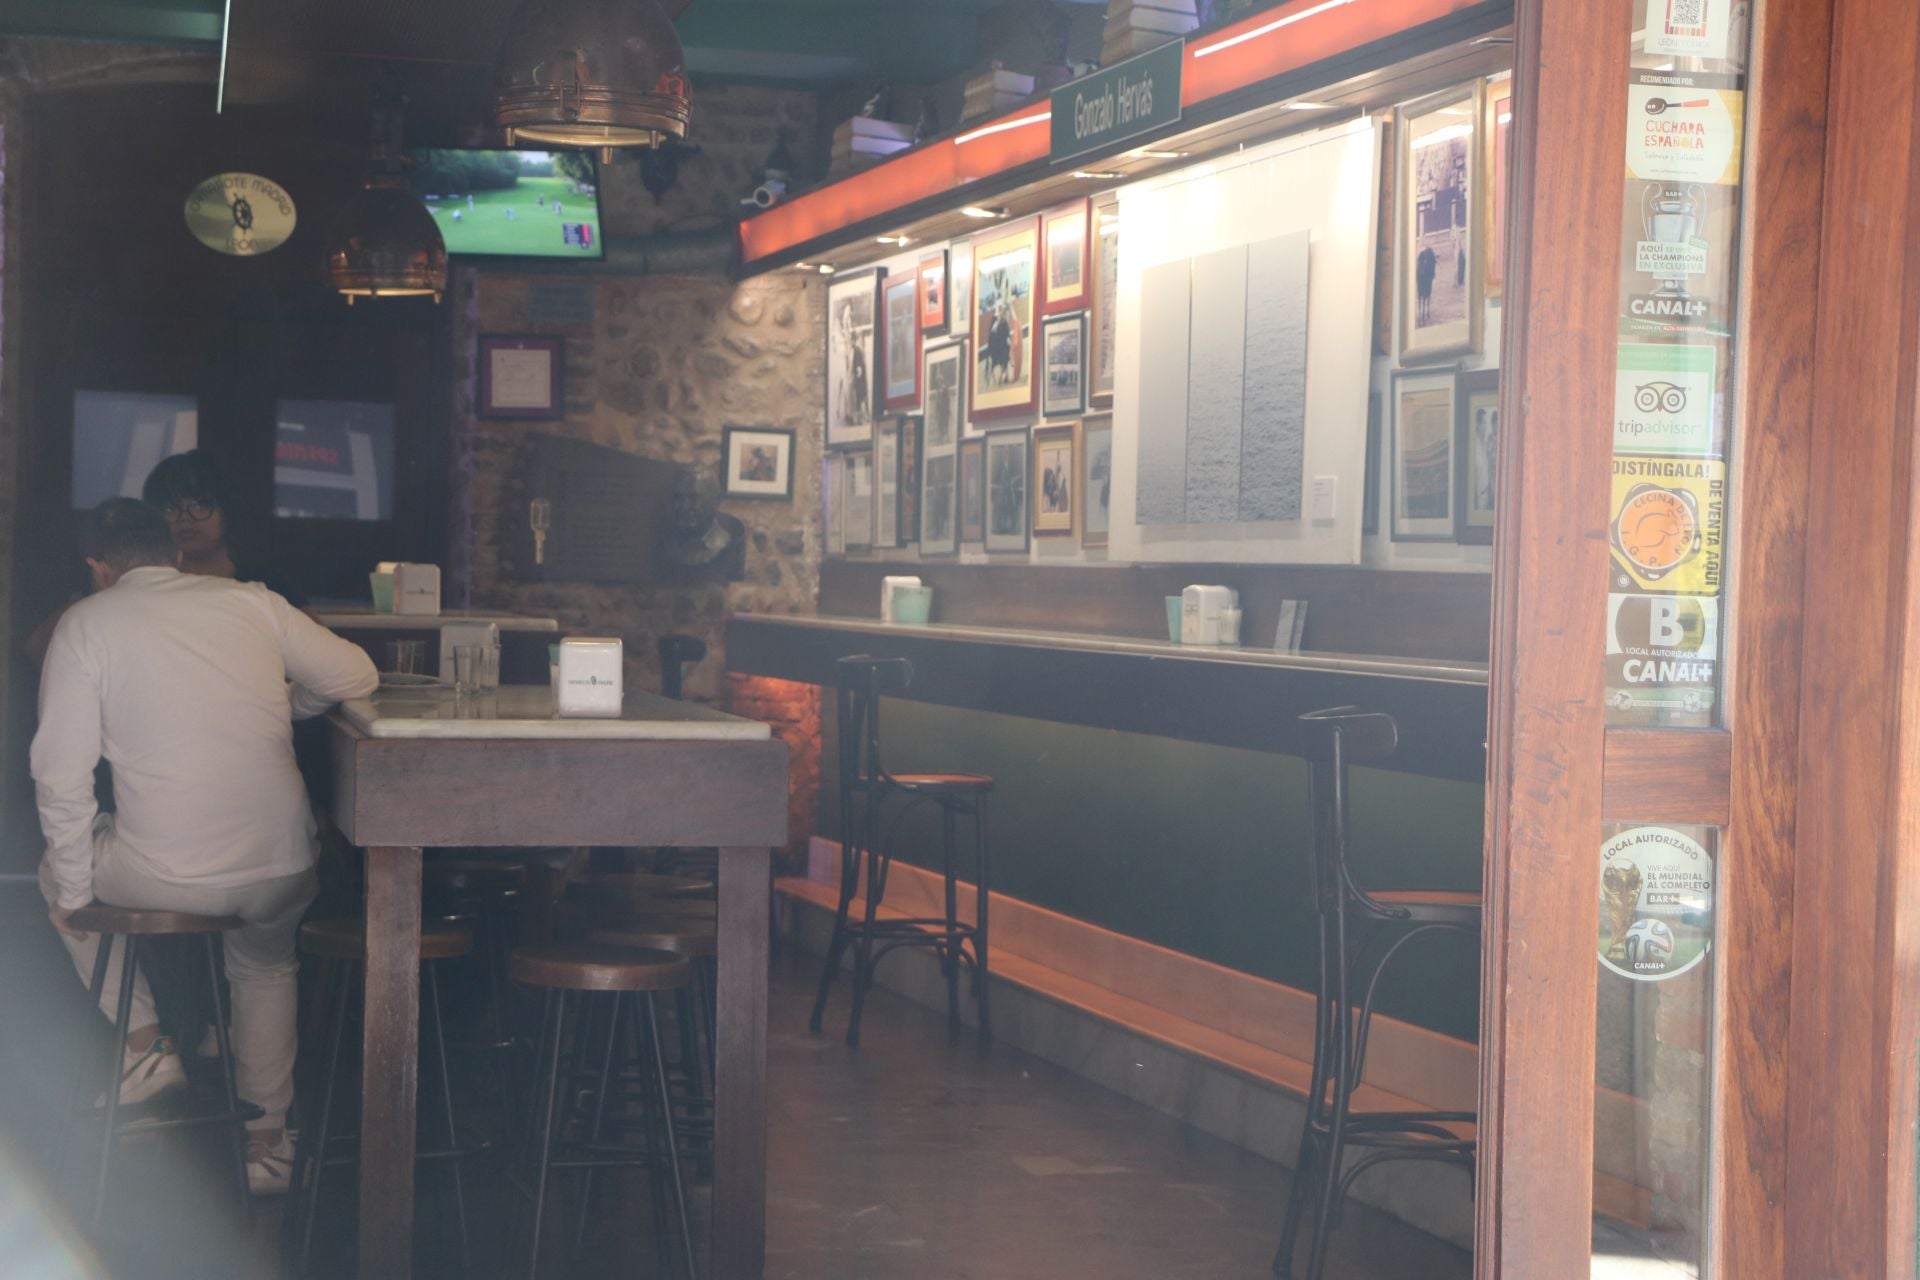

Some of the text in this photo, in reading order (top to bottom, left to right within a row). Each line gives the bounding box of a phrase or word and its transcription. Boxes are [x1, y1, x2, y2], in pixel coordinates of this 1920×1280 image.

[1640, 75, 1695, 86] RECOMENDADO POR:
[1074, 70, 1153, 139] Gonzalo Hervás
[1645, 119, 1705, 135] CUCHARA
[1652, 254, 1704, 262] CHAMPIONS
[1654, 262, 1703, 270] EXCLUSIVA
[1631, 299, 1707, 316] CANAL+
[1618, 420, 1697, 436] tripadvisor
[1709, 479, 1723, 497] DE
[1634, 494, 1675, 508] CECINA
[1707, 500, 1722, 546] VENTA
[1625, 647, 1699, 658] LOCAL AUTORIZADO
[1622, 658, 1713, 682] CANAL+
[1603, 834, 1698, 860] LOCAL AUTORIZADO
[1647, 881, 1711, 889] AL COMPLETO
